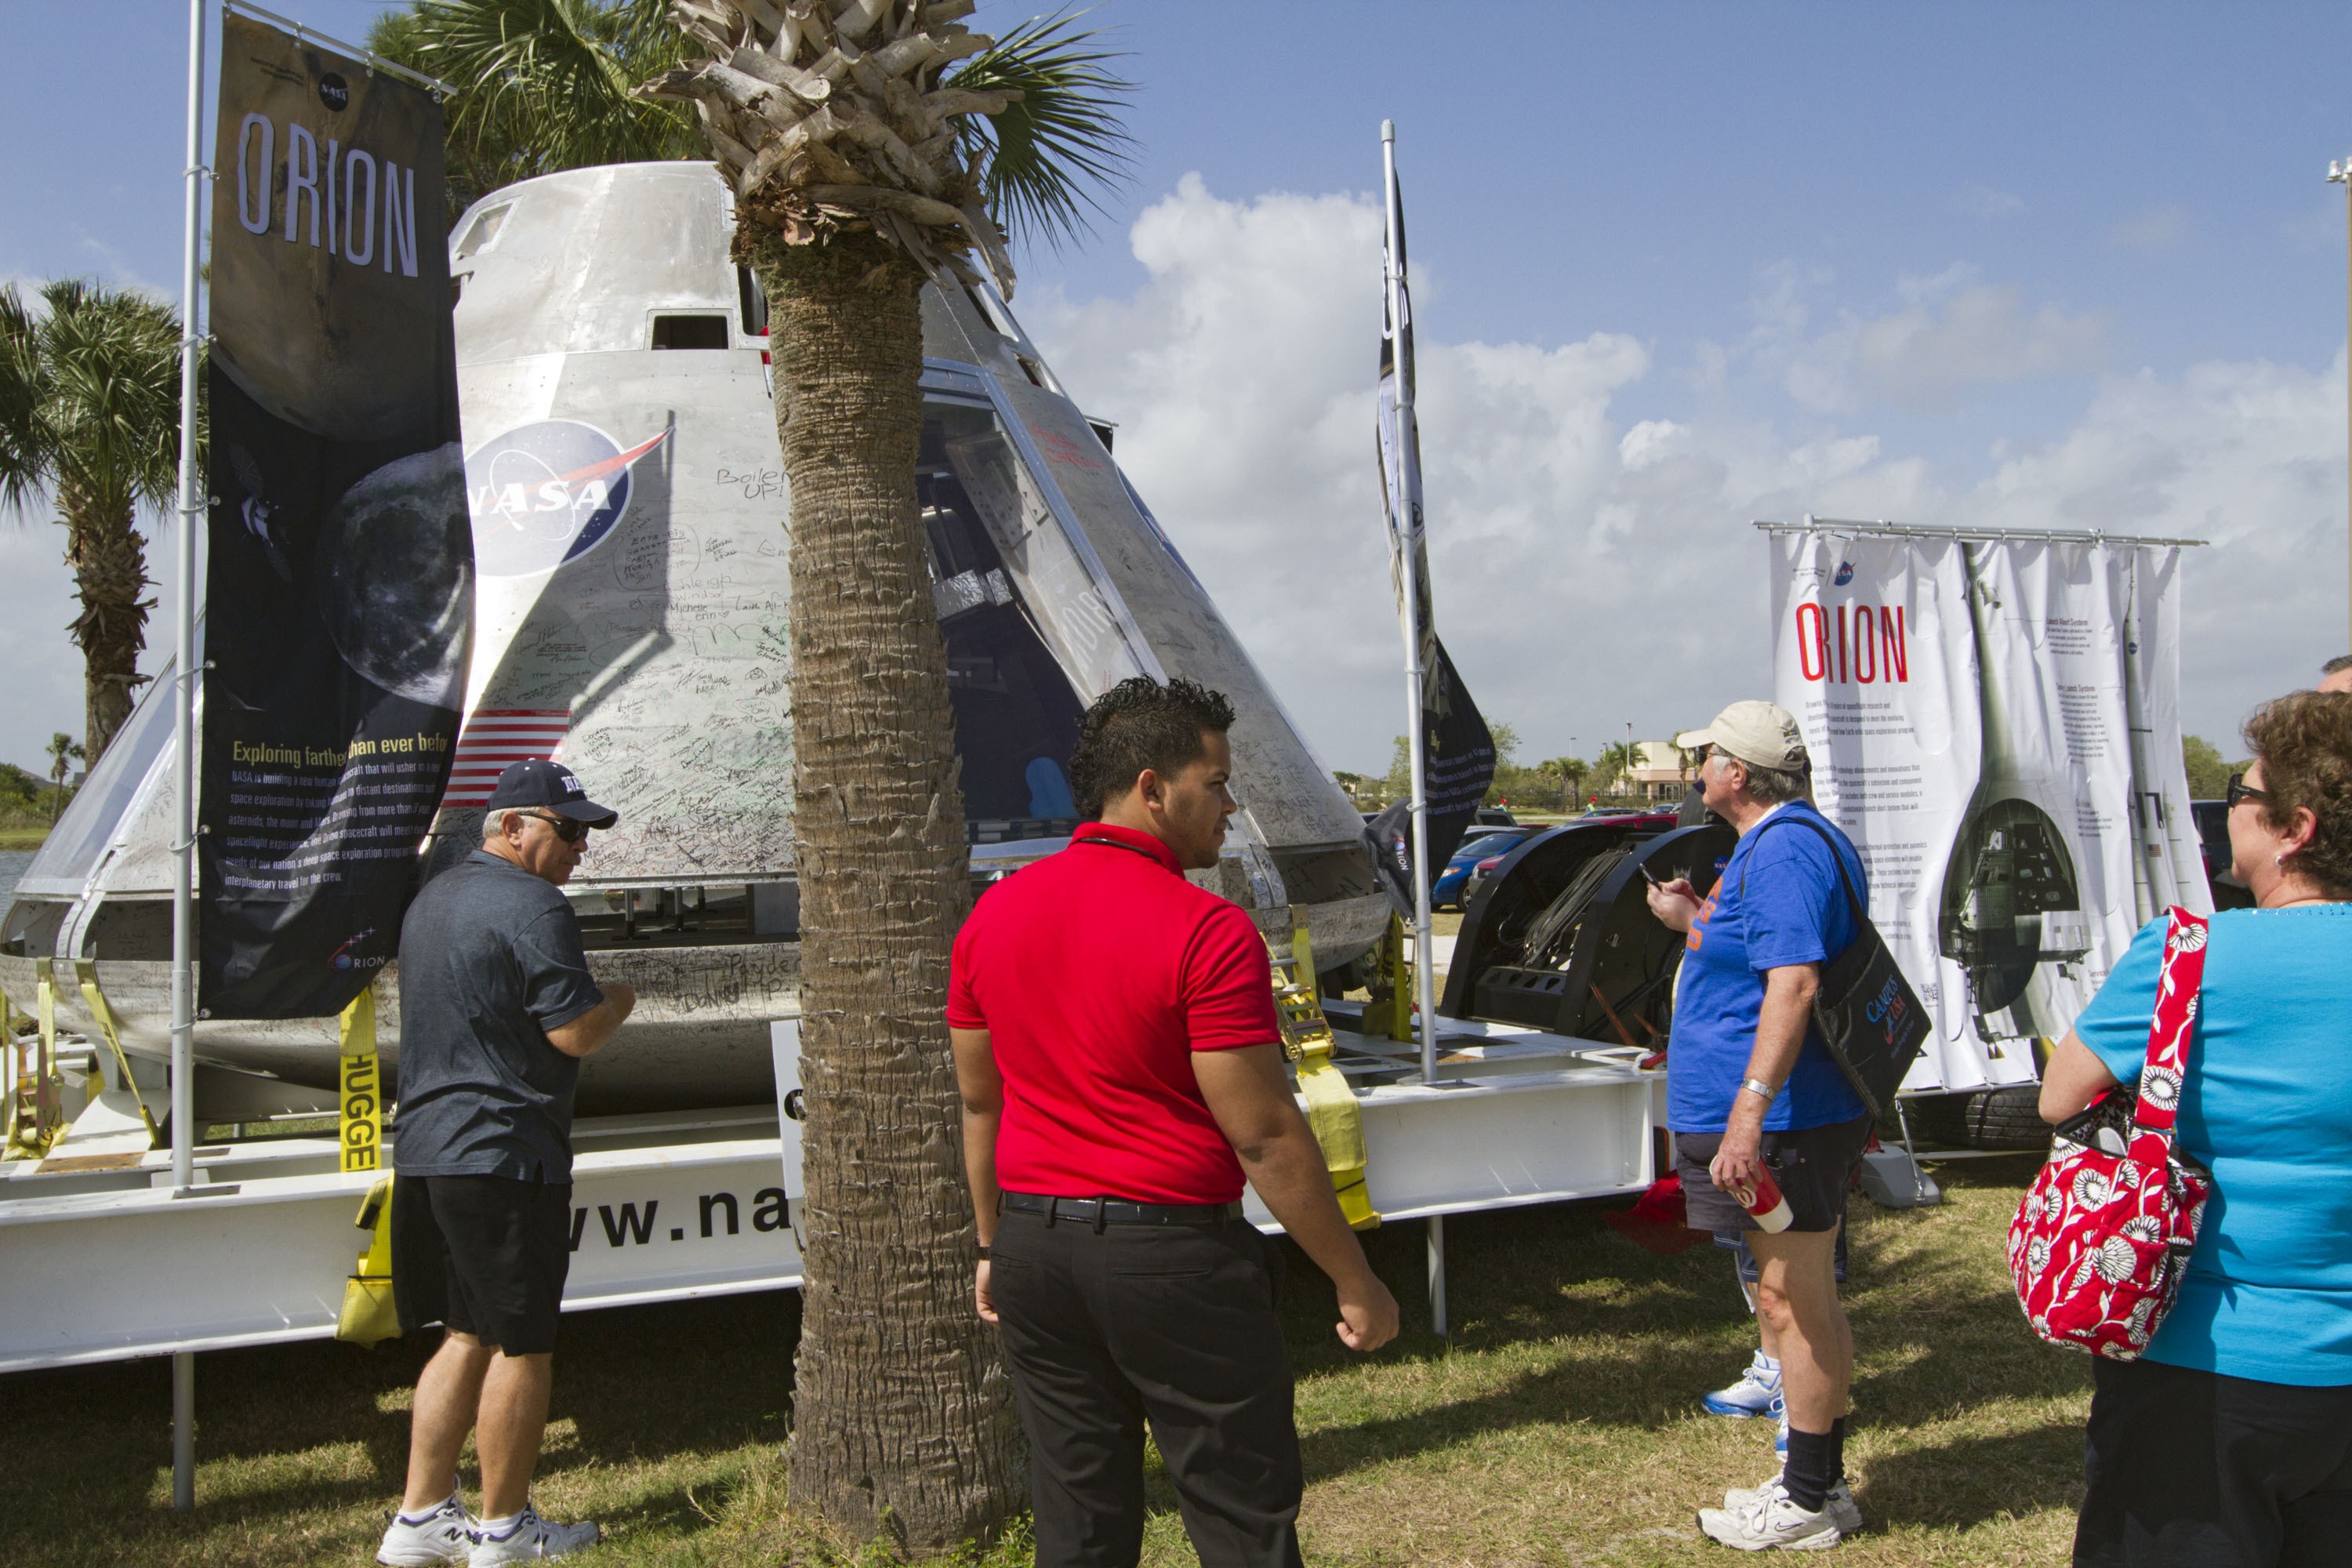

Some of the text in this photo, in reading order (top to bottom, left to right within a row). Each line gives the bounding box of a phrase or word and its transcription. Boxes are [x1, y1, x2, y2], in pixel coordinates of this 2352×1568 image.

[238, 113, 419, 278] ORION
[233, 739, 302, 769] Exploring
[381, 736, 414, 753] ever
[232, 771, 252, 783] NASA
[255, 772, 261, 783] is
[263, 772, 292, 786] building
[365, 764, 379, 775] that
[381, 762, 394, 774] will
[396, 762, 417, 773] usher
[230, 793, 252, 804] space
[254, 794, 296, 807] exploration
[296, 797, 304, 808] by
[347, 786, 354, 797] to
[356, 784, 381, 796] distant
[228, 815, 264, 828] asteroids,
[267, 816, 278, 828] the
[279, 818, 299, 829] moon
[299, 817, 313, 829] and
[358, 804, 376, 816] from
[377, 805, 395, 816] more
[226, 836, 268, 849] spaceflight
[322, 829, 339, 844] Orion
[339, 826, 377, 839] spacecraft
[379, 824, 393, 837] will
[249, 857, 257, 869] of
[259, 861, 271, 869] our
[272, 858, 302, 870] nation's
[303, 855, 319, 867] deep
[319, 850, 339, 862] space
[342, 847, 383, 862] exploration
[225, 872, 343, 891] interplanetary travel for the crew.
[346, 1054, 376, 1173] HUGGE
